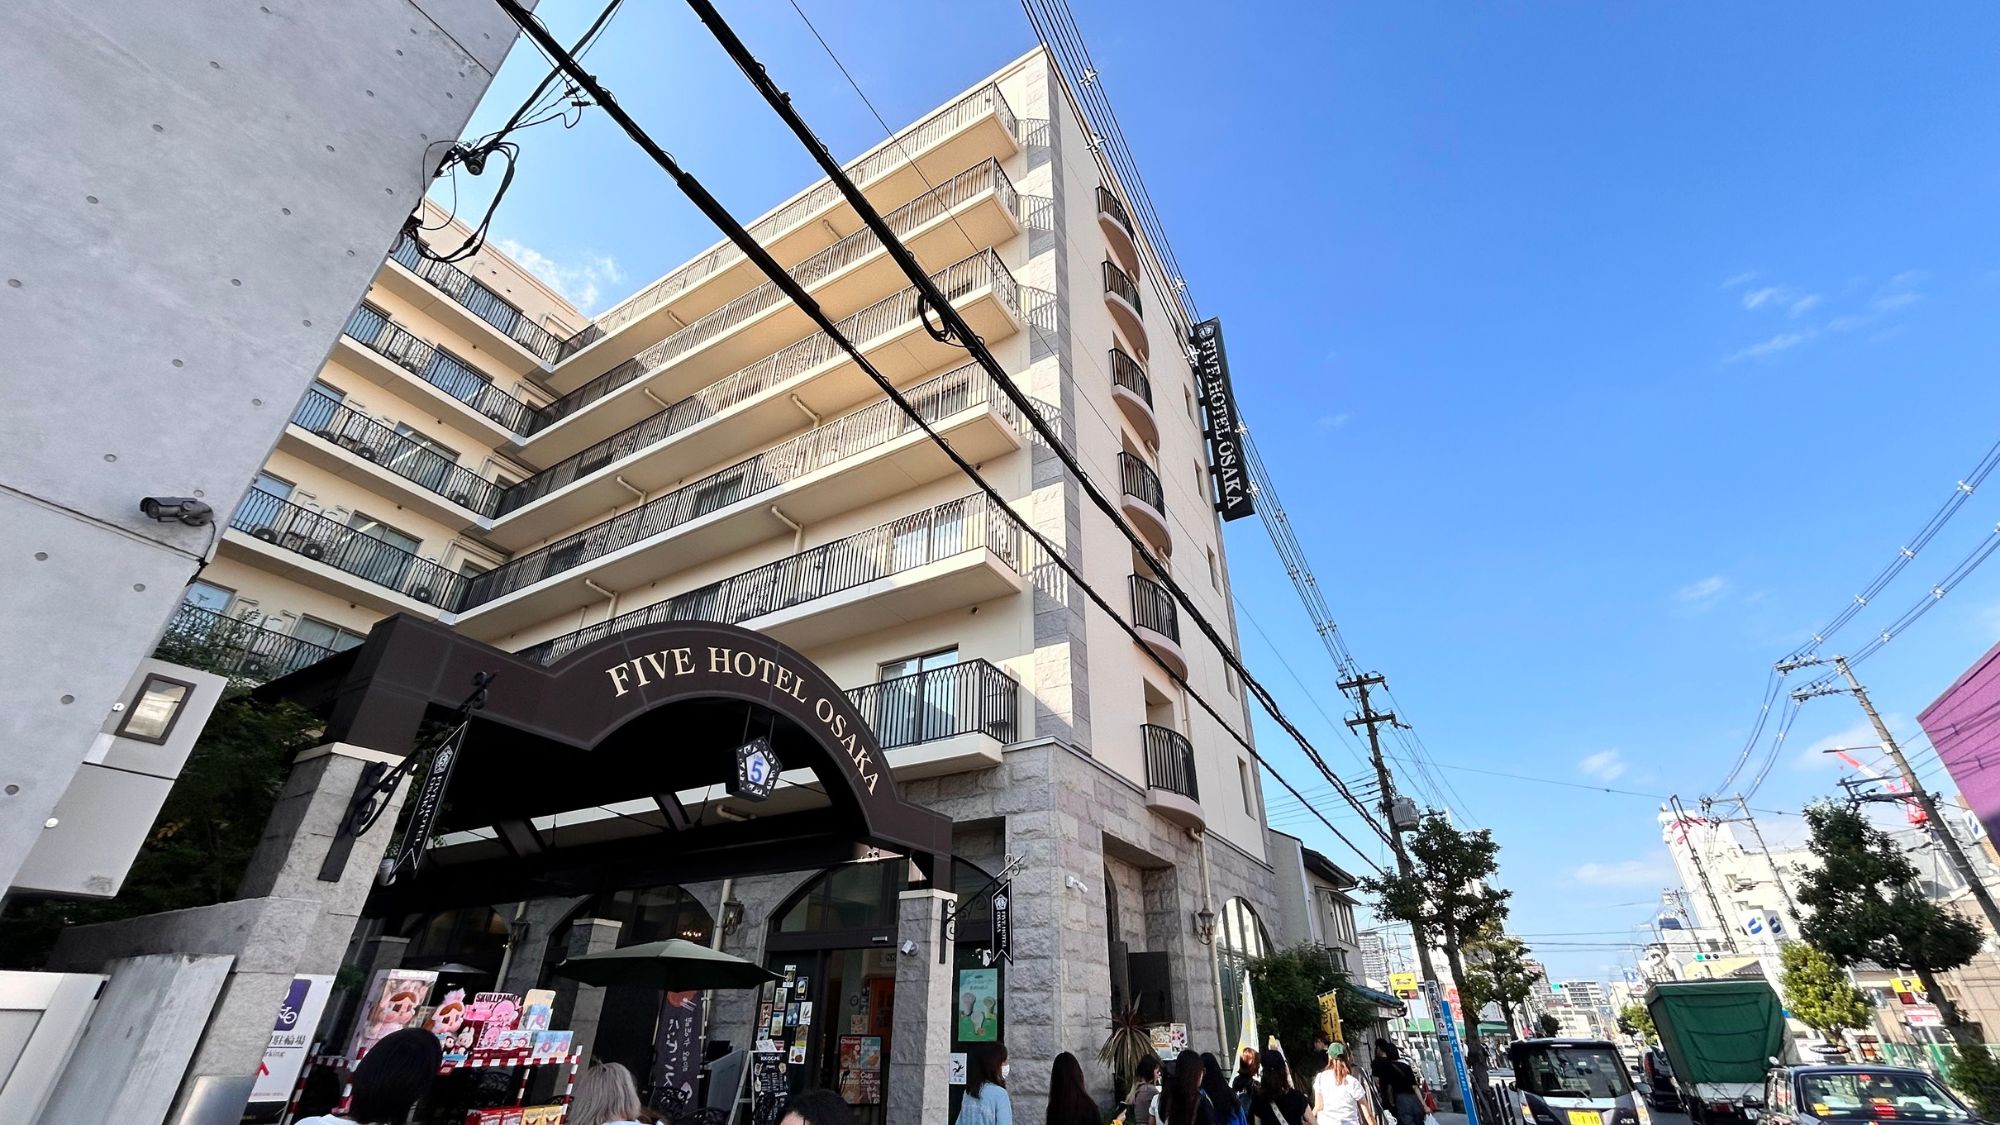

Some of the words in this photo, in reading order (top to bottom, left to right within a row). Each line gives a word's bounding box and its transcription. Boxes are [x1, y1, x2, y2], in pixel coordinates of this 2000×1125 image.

[1202, 337, 1221, 378] FIVE
[1208, 378, 1231, 438] HOTEL
[1217, 441, 1243, 509] OSAKA
[605, 647, 696, 697] FIVE
[707, 646, 808, 703] HOTEL
[815, 697, 880, 796] OSAKA
[751, 760, 764, 782] 5
[270, 1035, 306, 1046] 駐輪場
